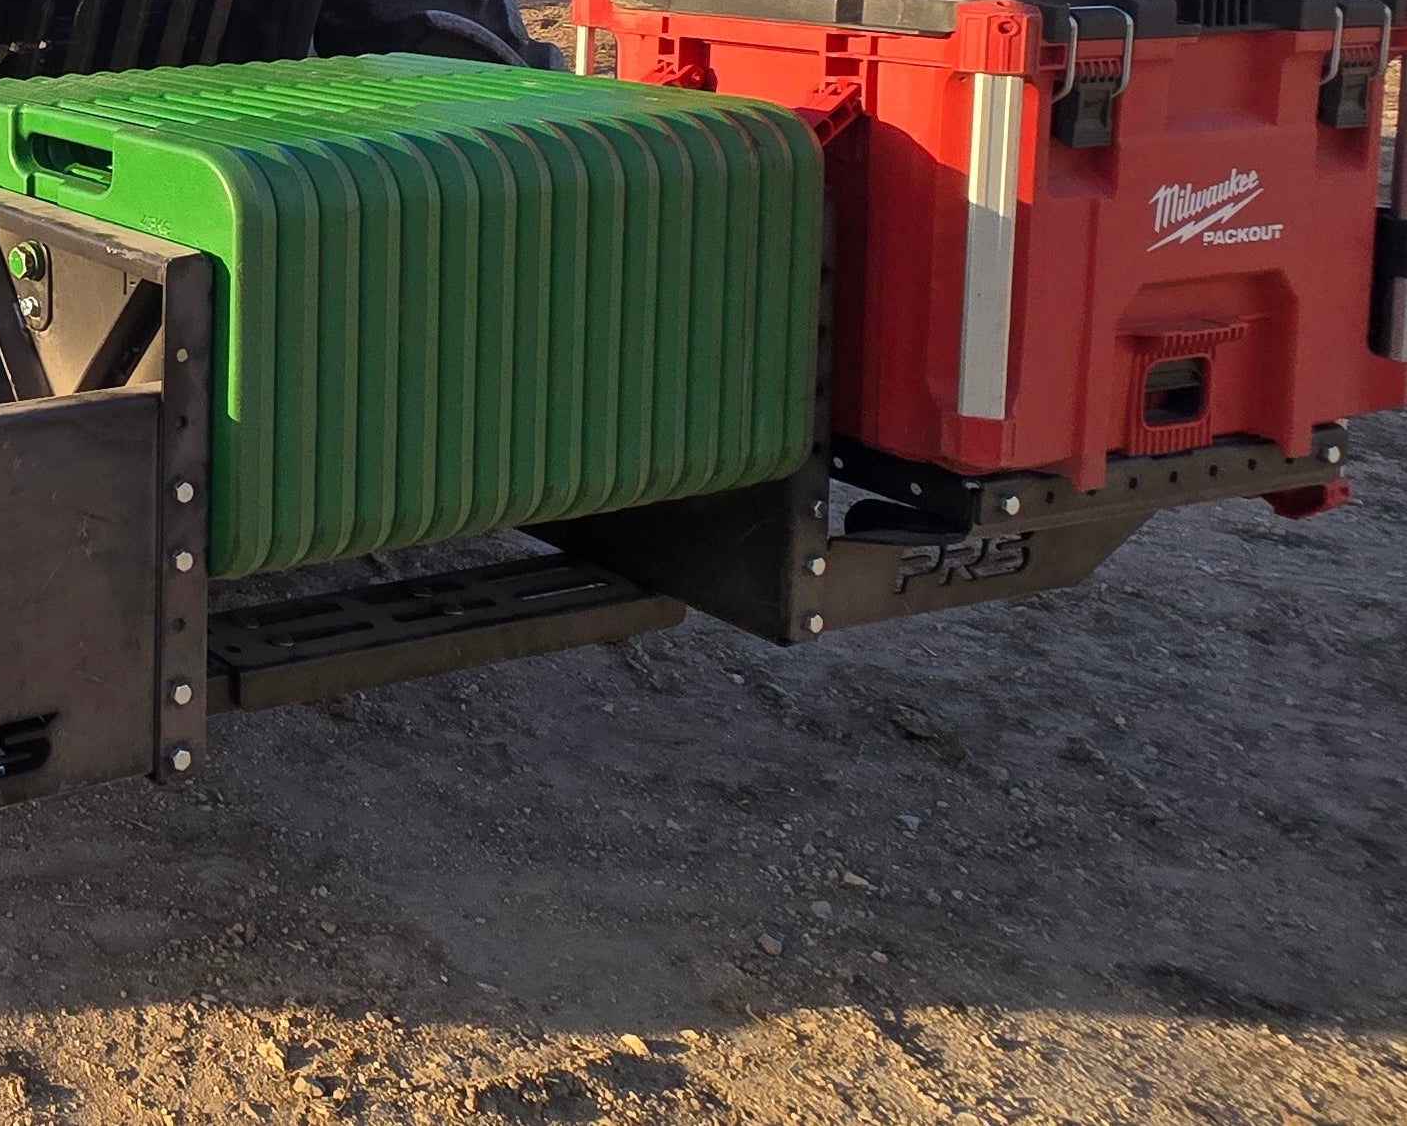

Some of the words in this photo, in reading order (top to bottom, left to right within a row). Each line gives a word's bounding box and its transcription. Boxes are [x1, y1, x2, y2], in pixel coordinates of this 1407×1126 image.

[1148, 167, 1260, 234] Milwaukee
[1202, 224, 1284, 246] PACKOUT
[893, 530, 1036, 594] PRS
